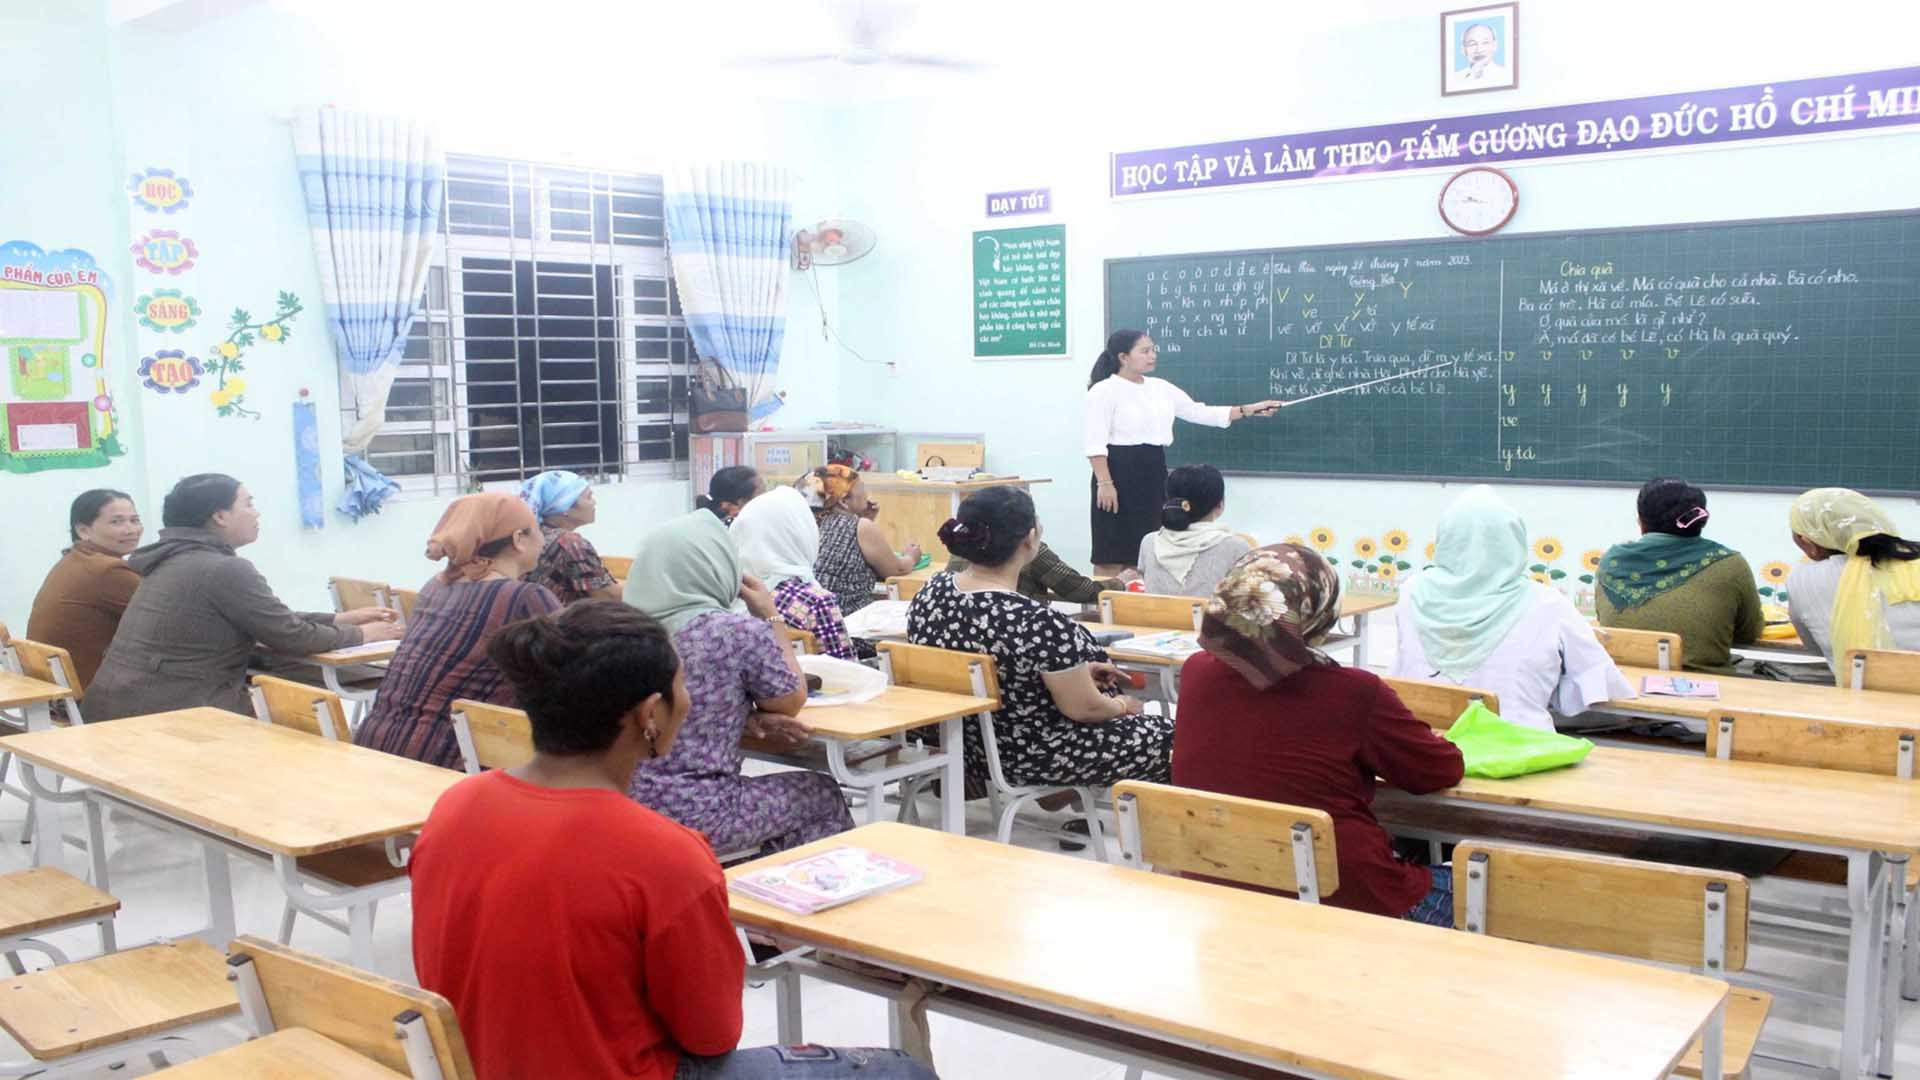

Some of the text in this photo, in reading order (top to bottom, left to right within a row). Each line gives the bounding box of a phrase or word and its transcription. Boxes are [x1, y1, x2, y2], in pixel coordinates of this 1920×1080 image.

[1121, 85, 1920, 191] HỌC TẬP VÀ LÀM THEO TẤM GƯƠNG ĐẠO ĐỨC HỒ CHÍ MI
[992, 192, 1045, 214] DẠY TỐT
[1400, 281, 1414, 300] Y
[151, 362, 193, 386] TẠO
